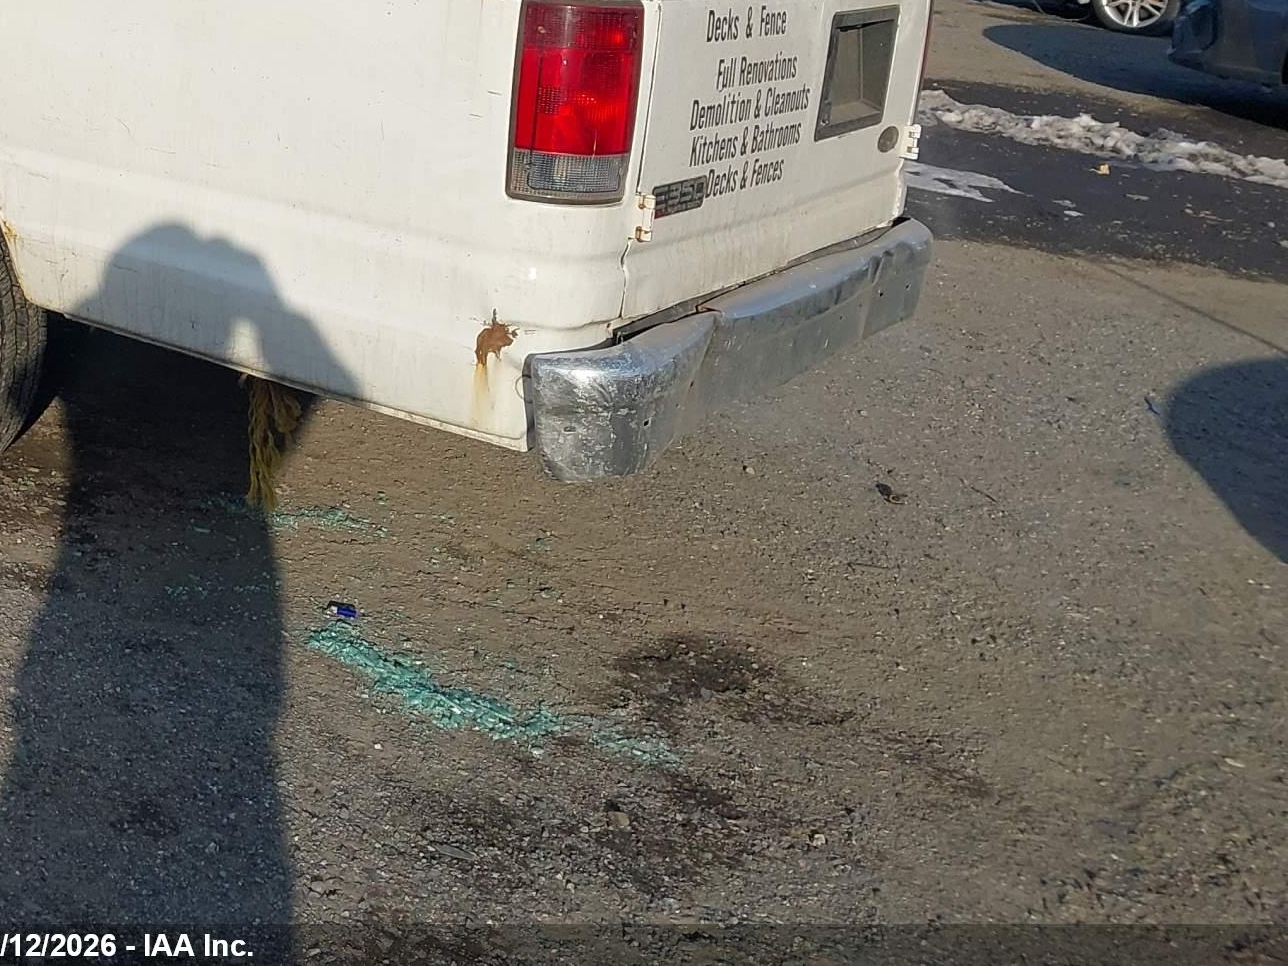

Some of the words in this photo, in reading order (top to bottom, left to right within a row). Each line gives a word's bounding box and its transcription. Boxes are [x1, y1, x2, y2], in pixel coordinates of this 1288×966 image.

[706, 8, 740, 43] Decks
[746, 6, 753, 38] &
[760, 5, 787, 37] Fence
[716, 57, 737, 91] Full
[740, 52, 798, 82] Renovations
[689, 91, 751, 131] Demolition
[754, 91, 762, 119] &
[764, 84, 811, 117] Cleanouts
[689, 131, 738, 168] Kitchens
[740, 128, 749, 156] &
[751, 122, 802, 154] Bathrooms
[705, 168, 738, 199] Decks
[740, 161, 749, 191] &
[750, 158, 785, 188] Fences
